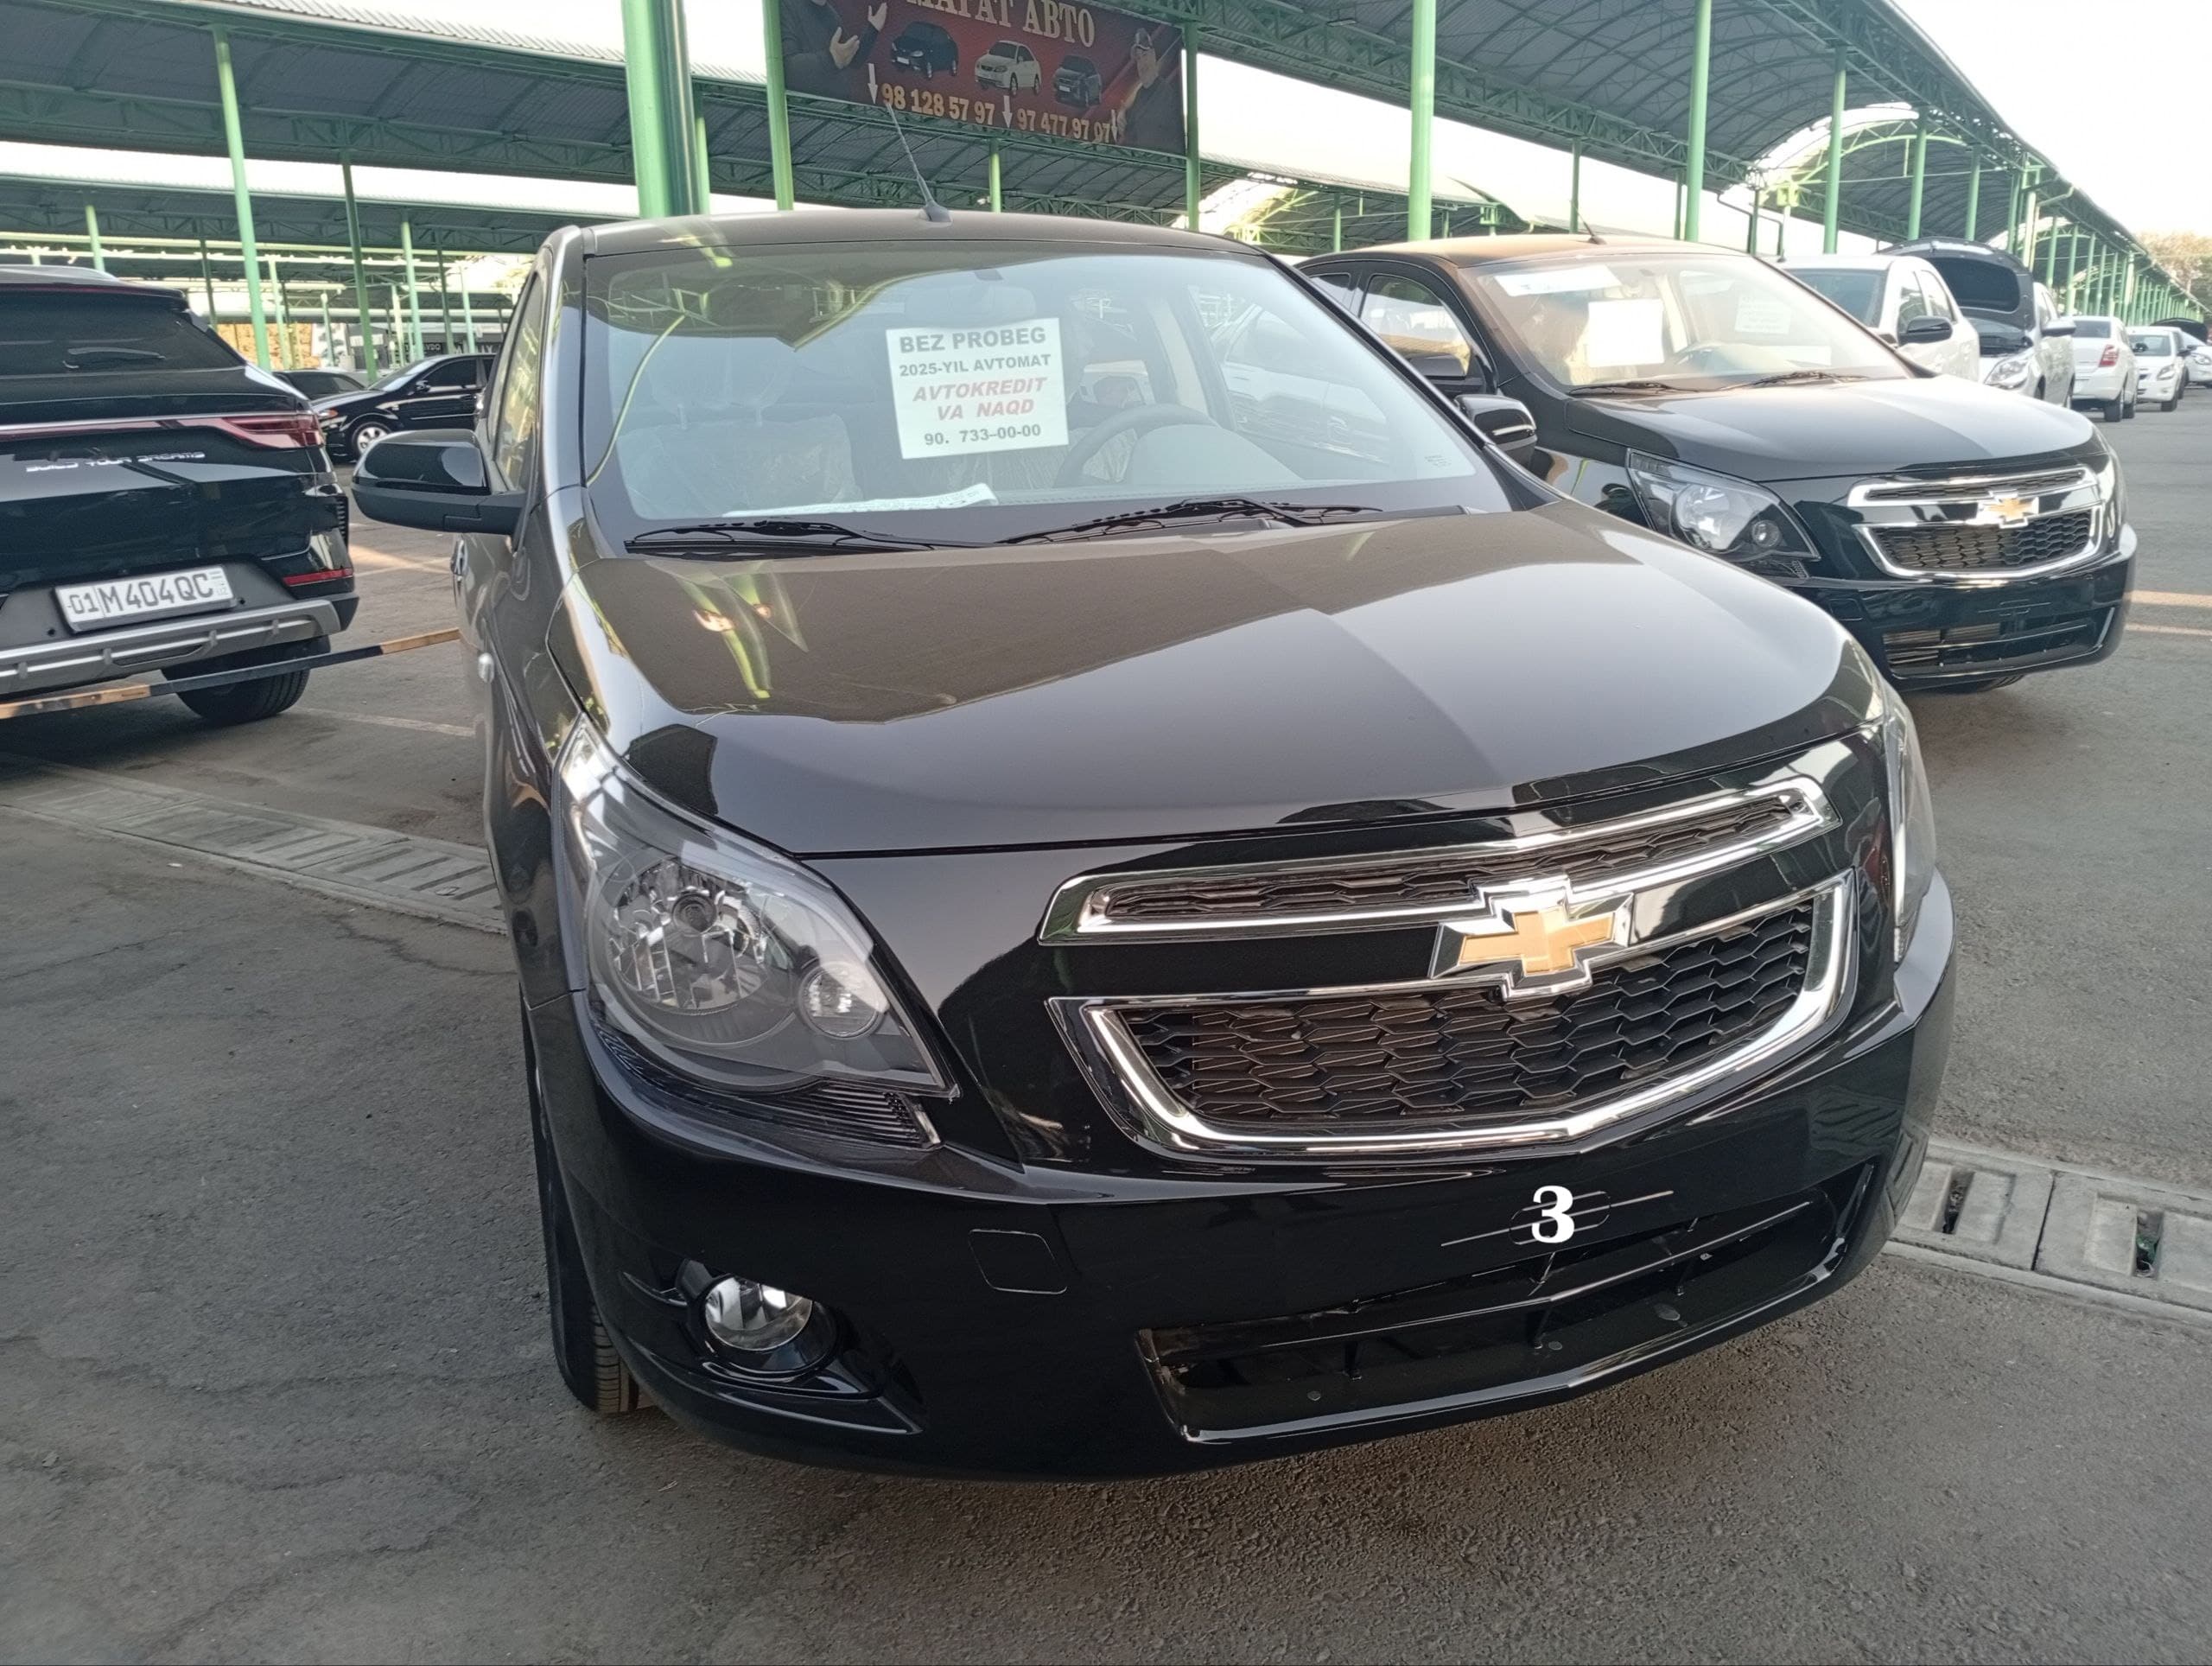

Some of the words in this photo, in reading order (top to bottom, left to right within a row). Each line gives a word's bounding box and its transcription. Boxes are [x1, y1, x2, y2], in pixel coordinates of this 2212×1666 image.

[1022, 0, 1095, 48] АВТО
[881, 83, 906, 110] 98
[911, 88, 944, 117] 128
[949, 96, 969, 121] 57
[974, 101, 995, 125] 97
[1017, 108, 1036, 131] 97
[1040, 112, 1067, 137] 477
[1071, 118, 1090, 140] 97
[899, 334, 945, 353] BEZ
[951, 327, 1046, 349] PROBEG
[899, 360, 969, 377] 2025-YIL
[973, 353, 1052, 372] AVTOMAT
[912, 377, 1048, 402] AVTOKREDIT
[938, 404, 963, 421] VA
[976, 398, 1035, 417] NAQD
[924, 432, 950, 446] 90.
